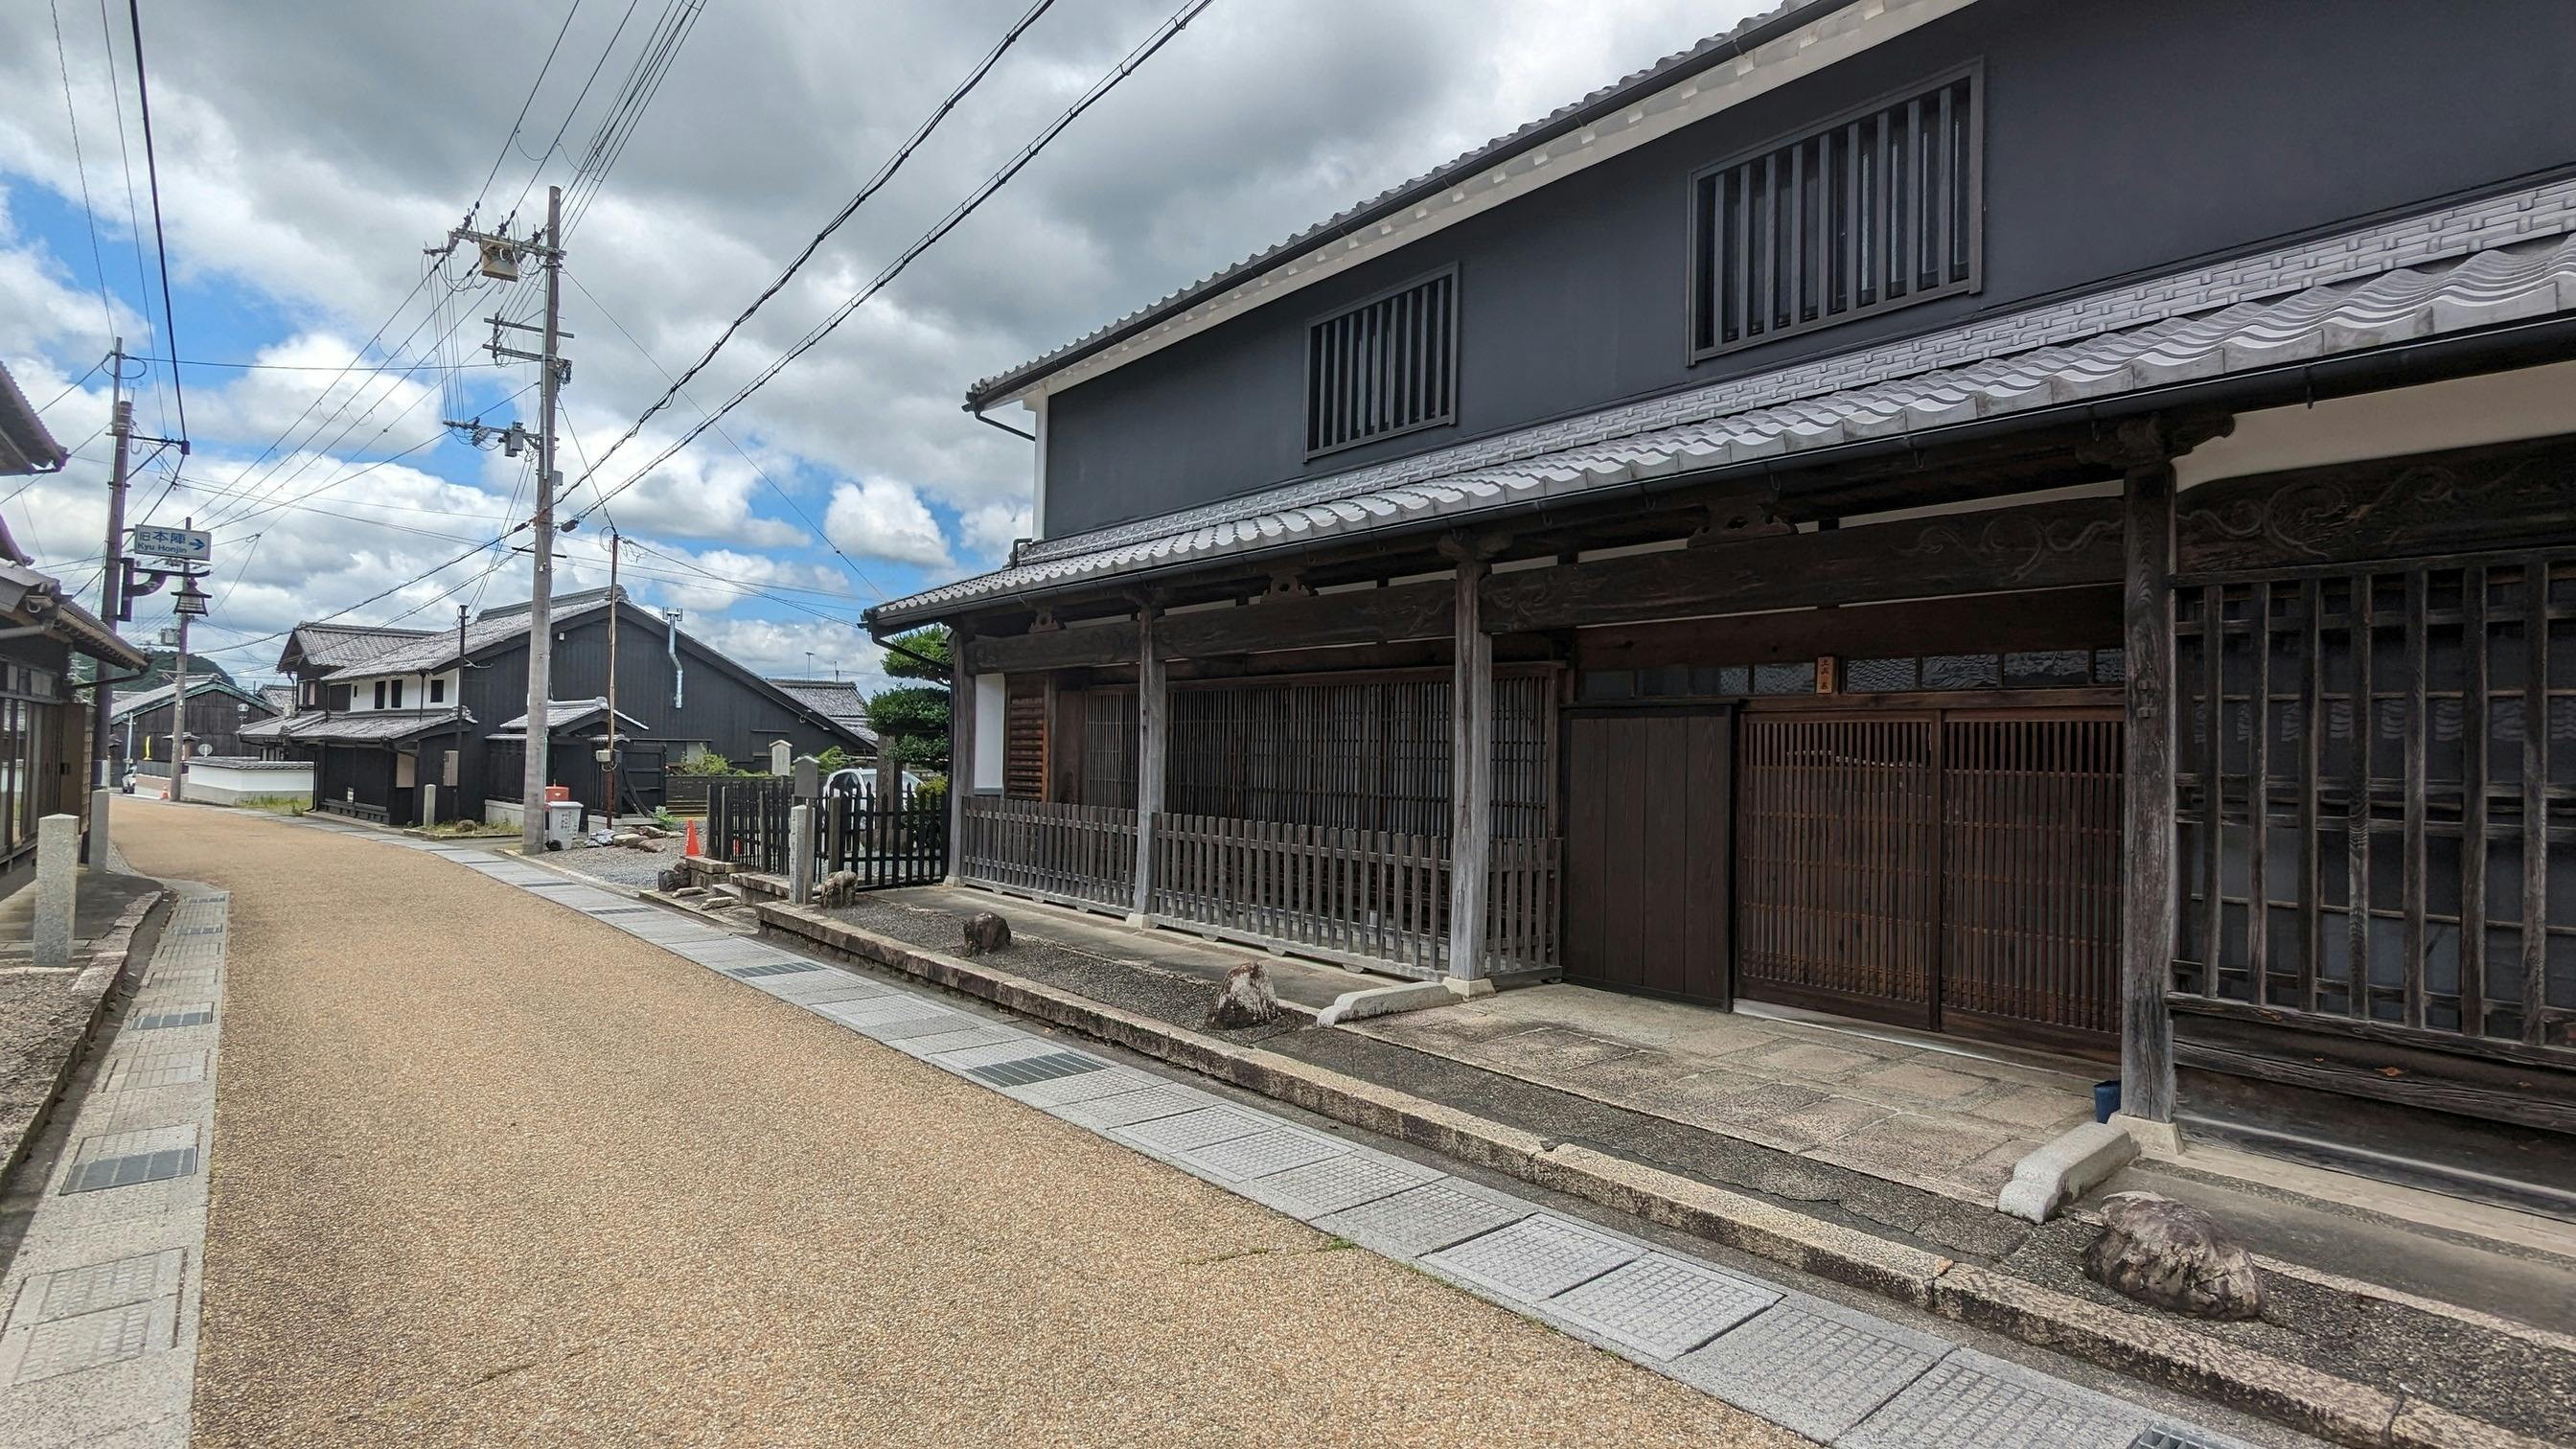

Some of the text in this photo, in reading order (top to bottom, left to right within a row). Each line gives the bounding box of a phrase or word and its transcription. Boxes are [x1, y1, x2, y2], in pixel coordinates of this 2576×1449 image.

[139, 530, 186, 544] 旧本陣
[137, 542, 187, 554] Kyu Honjin
